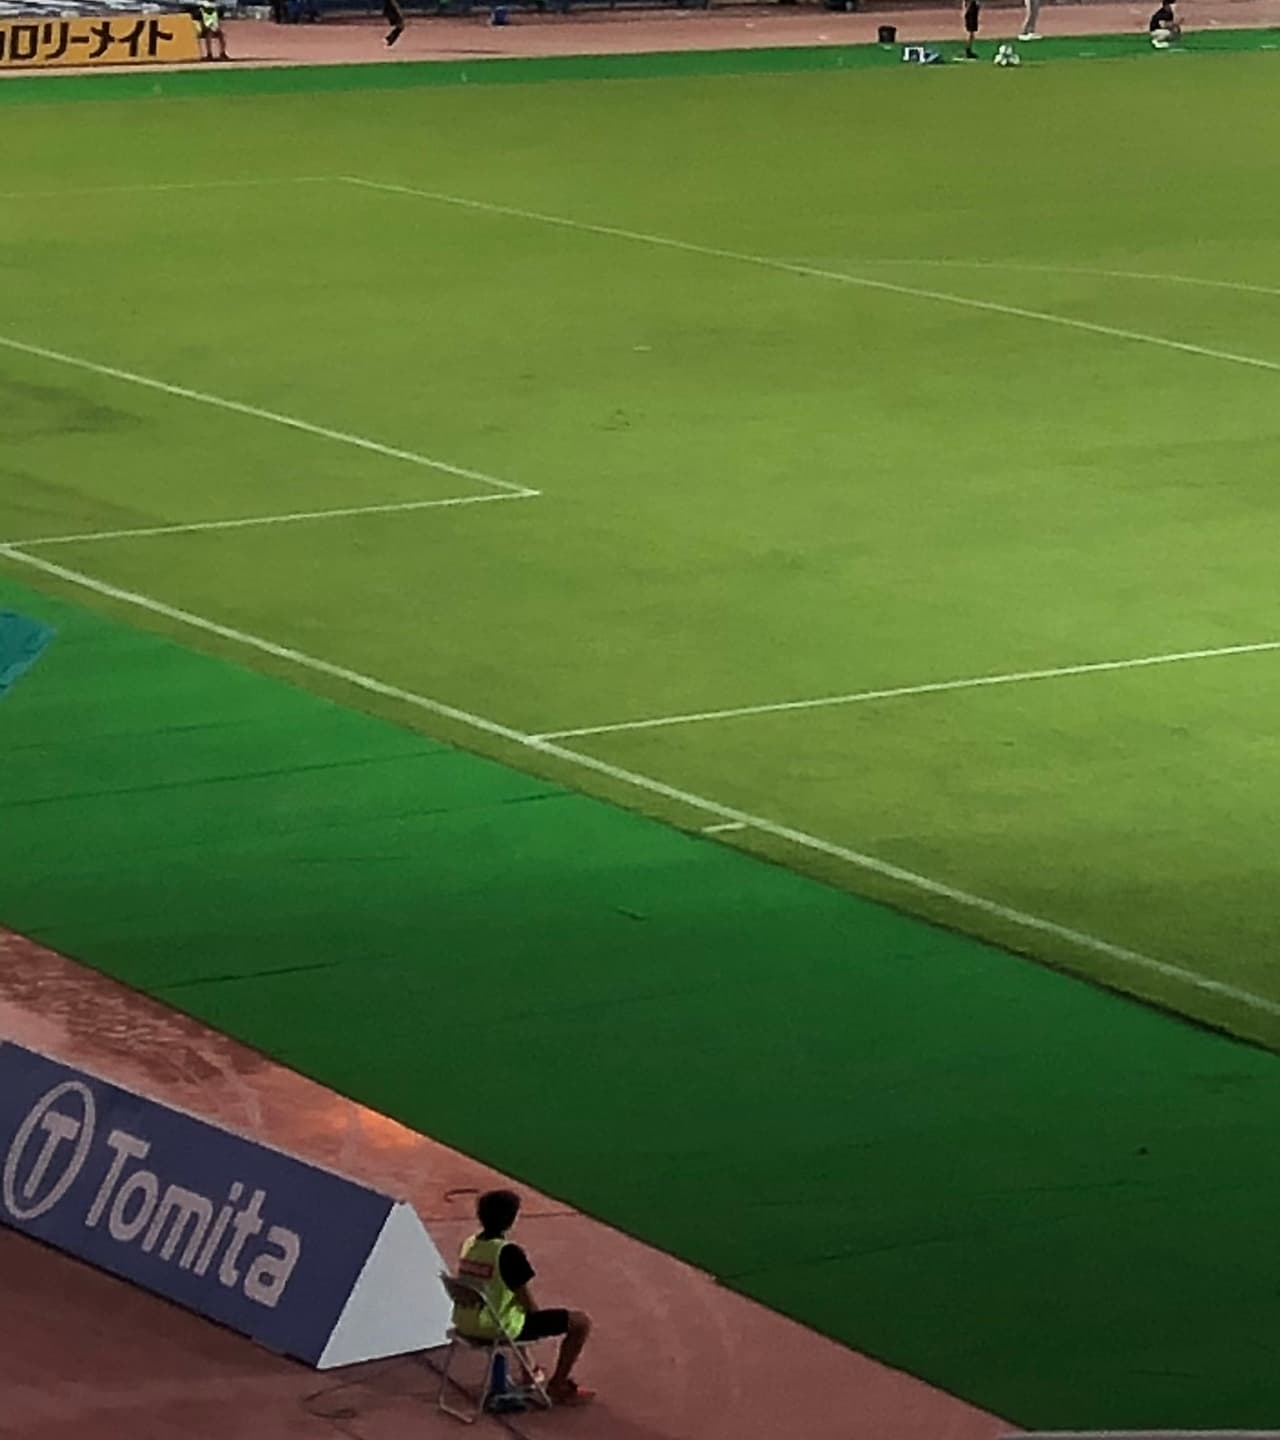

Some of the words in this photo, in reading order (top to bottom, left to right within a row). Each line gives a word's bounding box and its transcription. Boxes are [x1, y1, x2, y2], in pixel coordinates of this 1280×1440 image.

[0, 20, 174, 60] ロリーメイト
[86, 1128, 302, 1308] Tomita
